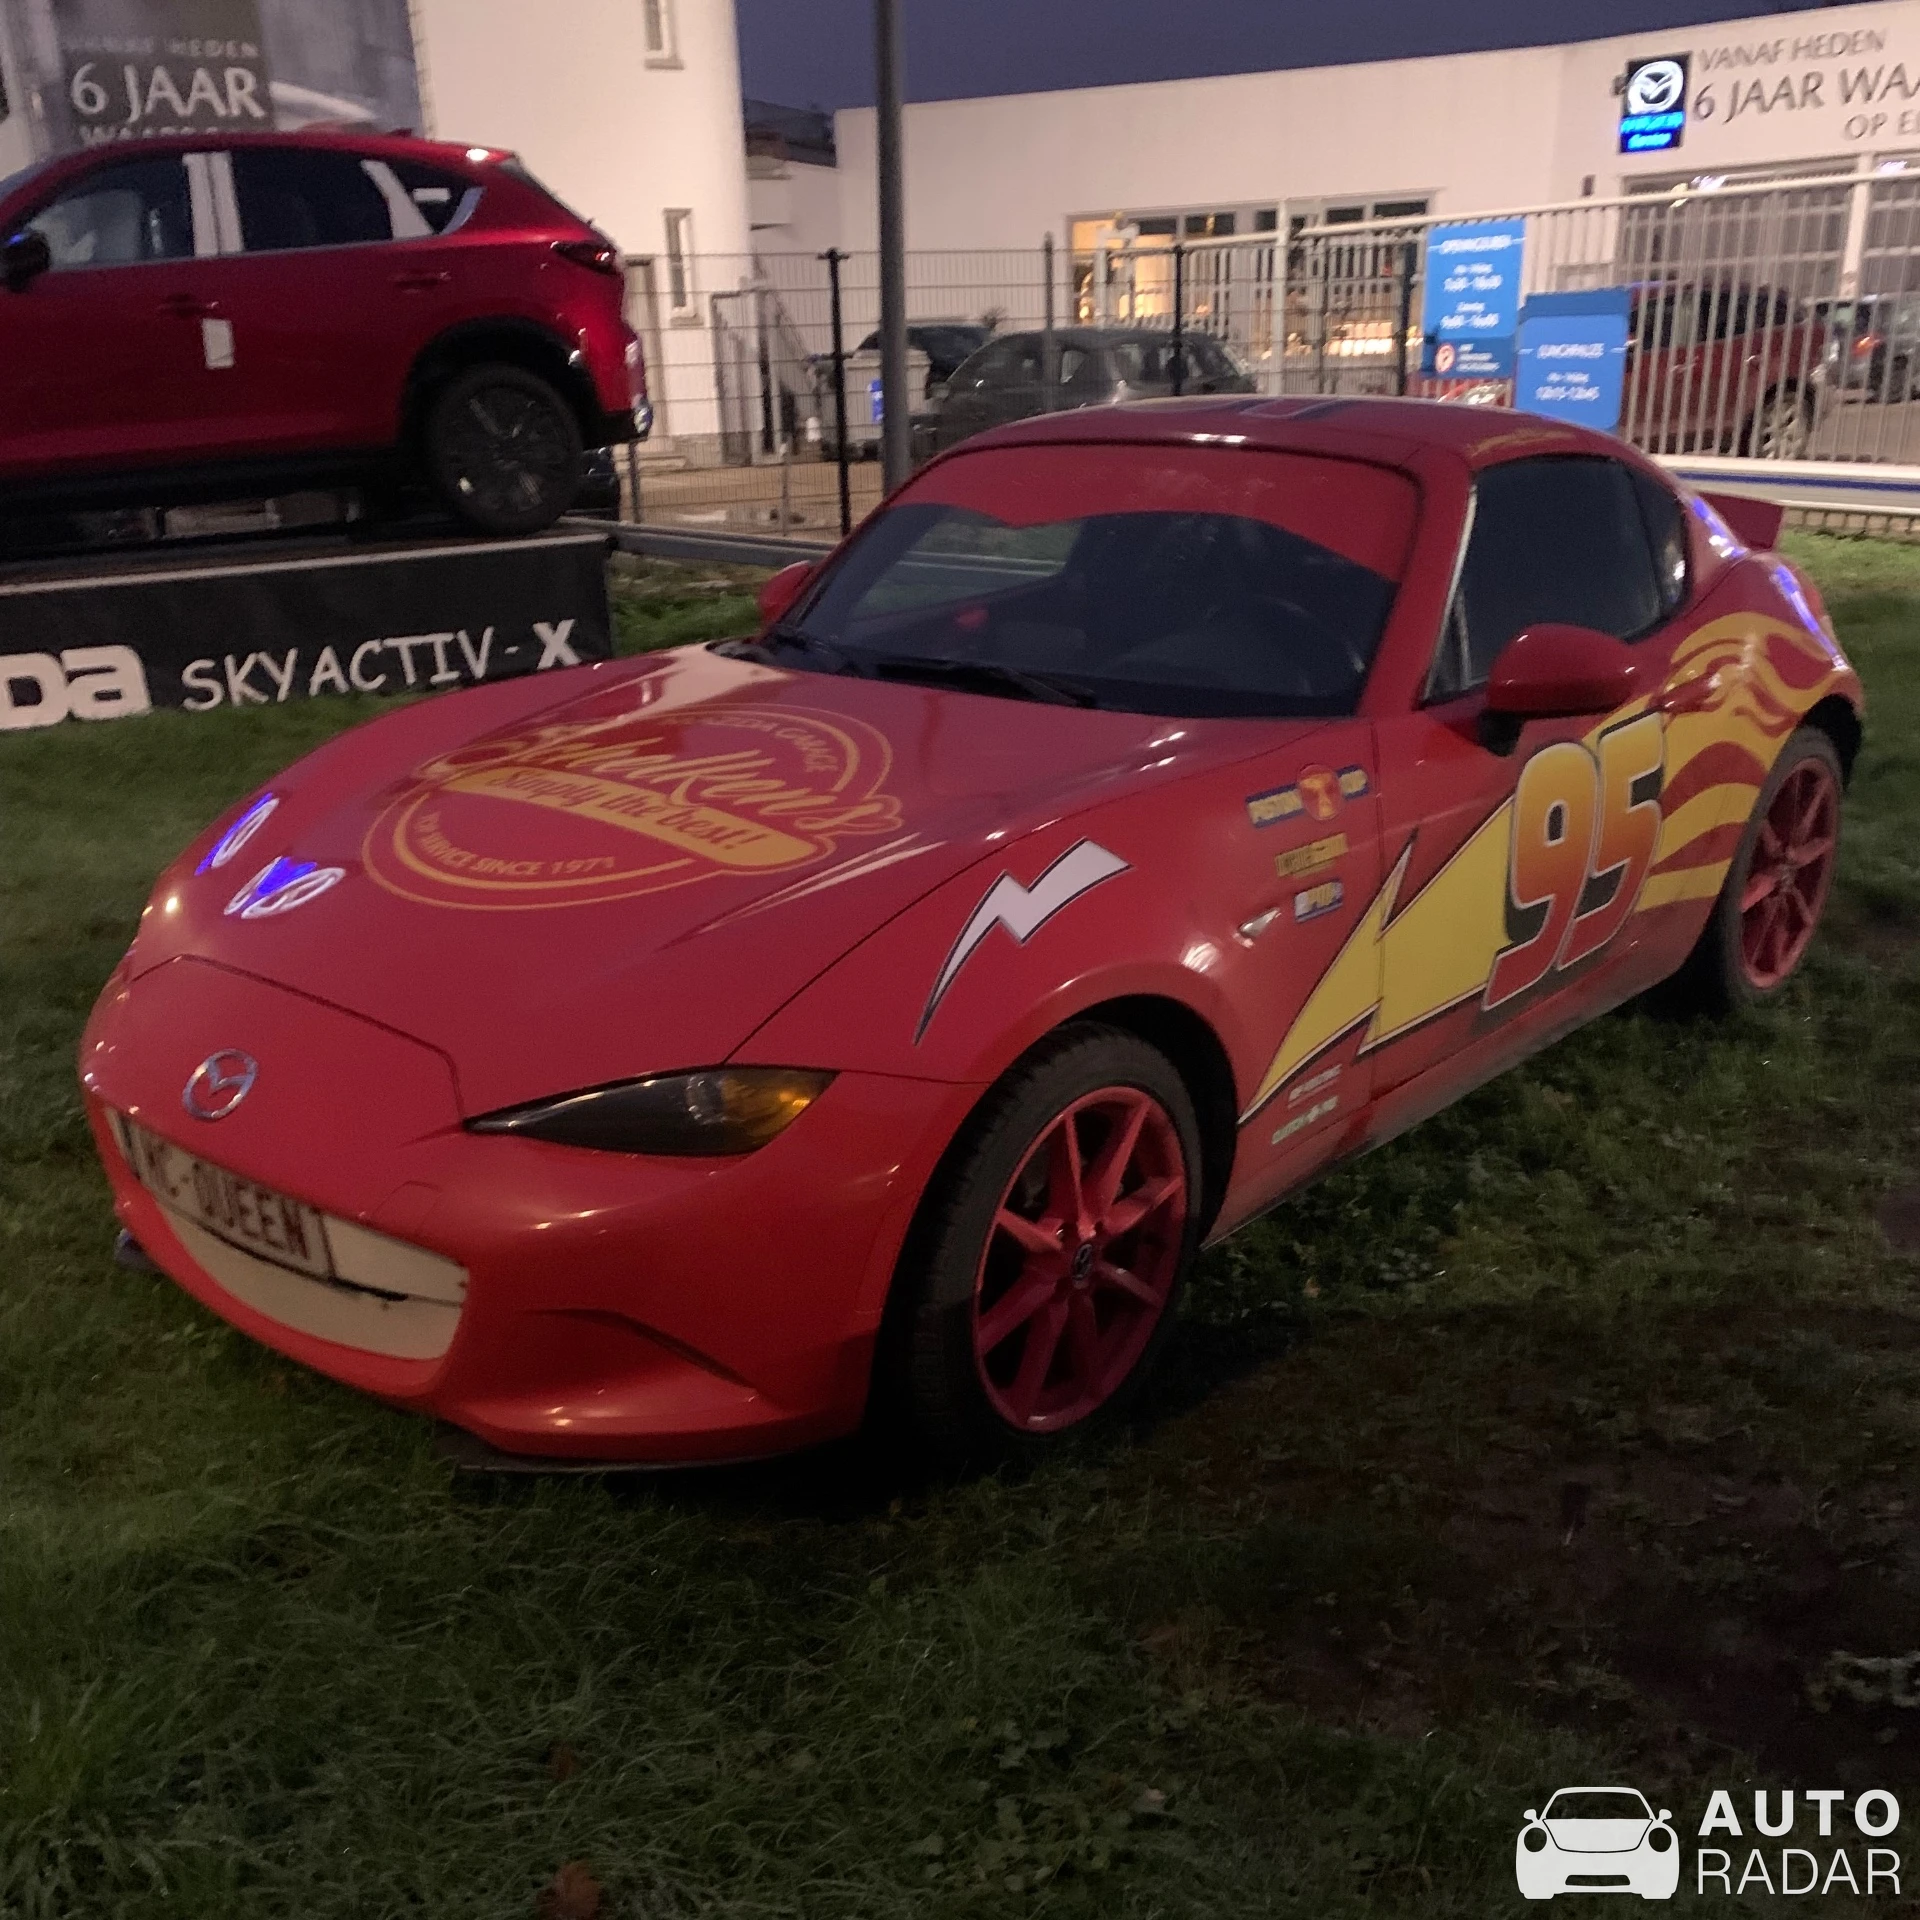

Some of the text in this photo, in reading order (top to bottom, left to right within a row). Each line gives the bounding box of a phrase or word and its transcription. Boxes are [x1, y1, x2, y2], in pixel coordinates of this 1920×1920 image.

[1700, 28, 1886, 72] VANAF HEDEN
[71, 62, 266, 123] 6 JAAR
[1692, 83, 1716, 121] 6
[1722, 70, 1825, 124] JAAR
[1844, 111, 1889, 140] OP
[485, 767, 769, 850] Simply the best!
[470, 856, 546, 876] SINCE
[1482, 712, 1663, 1011] 95
